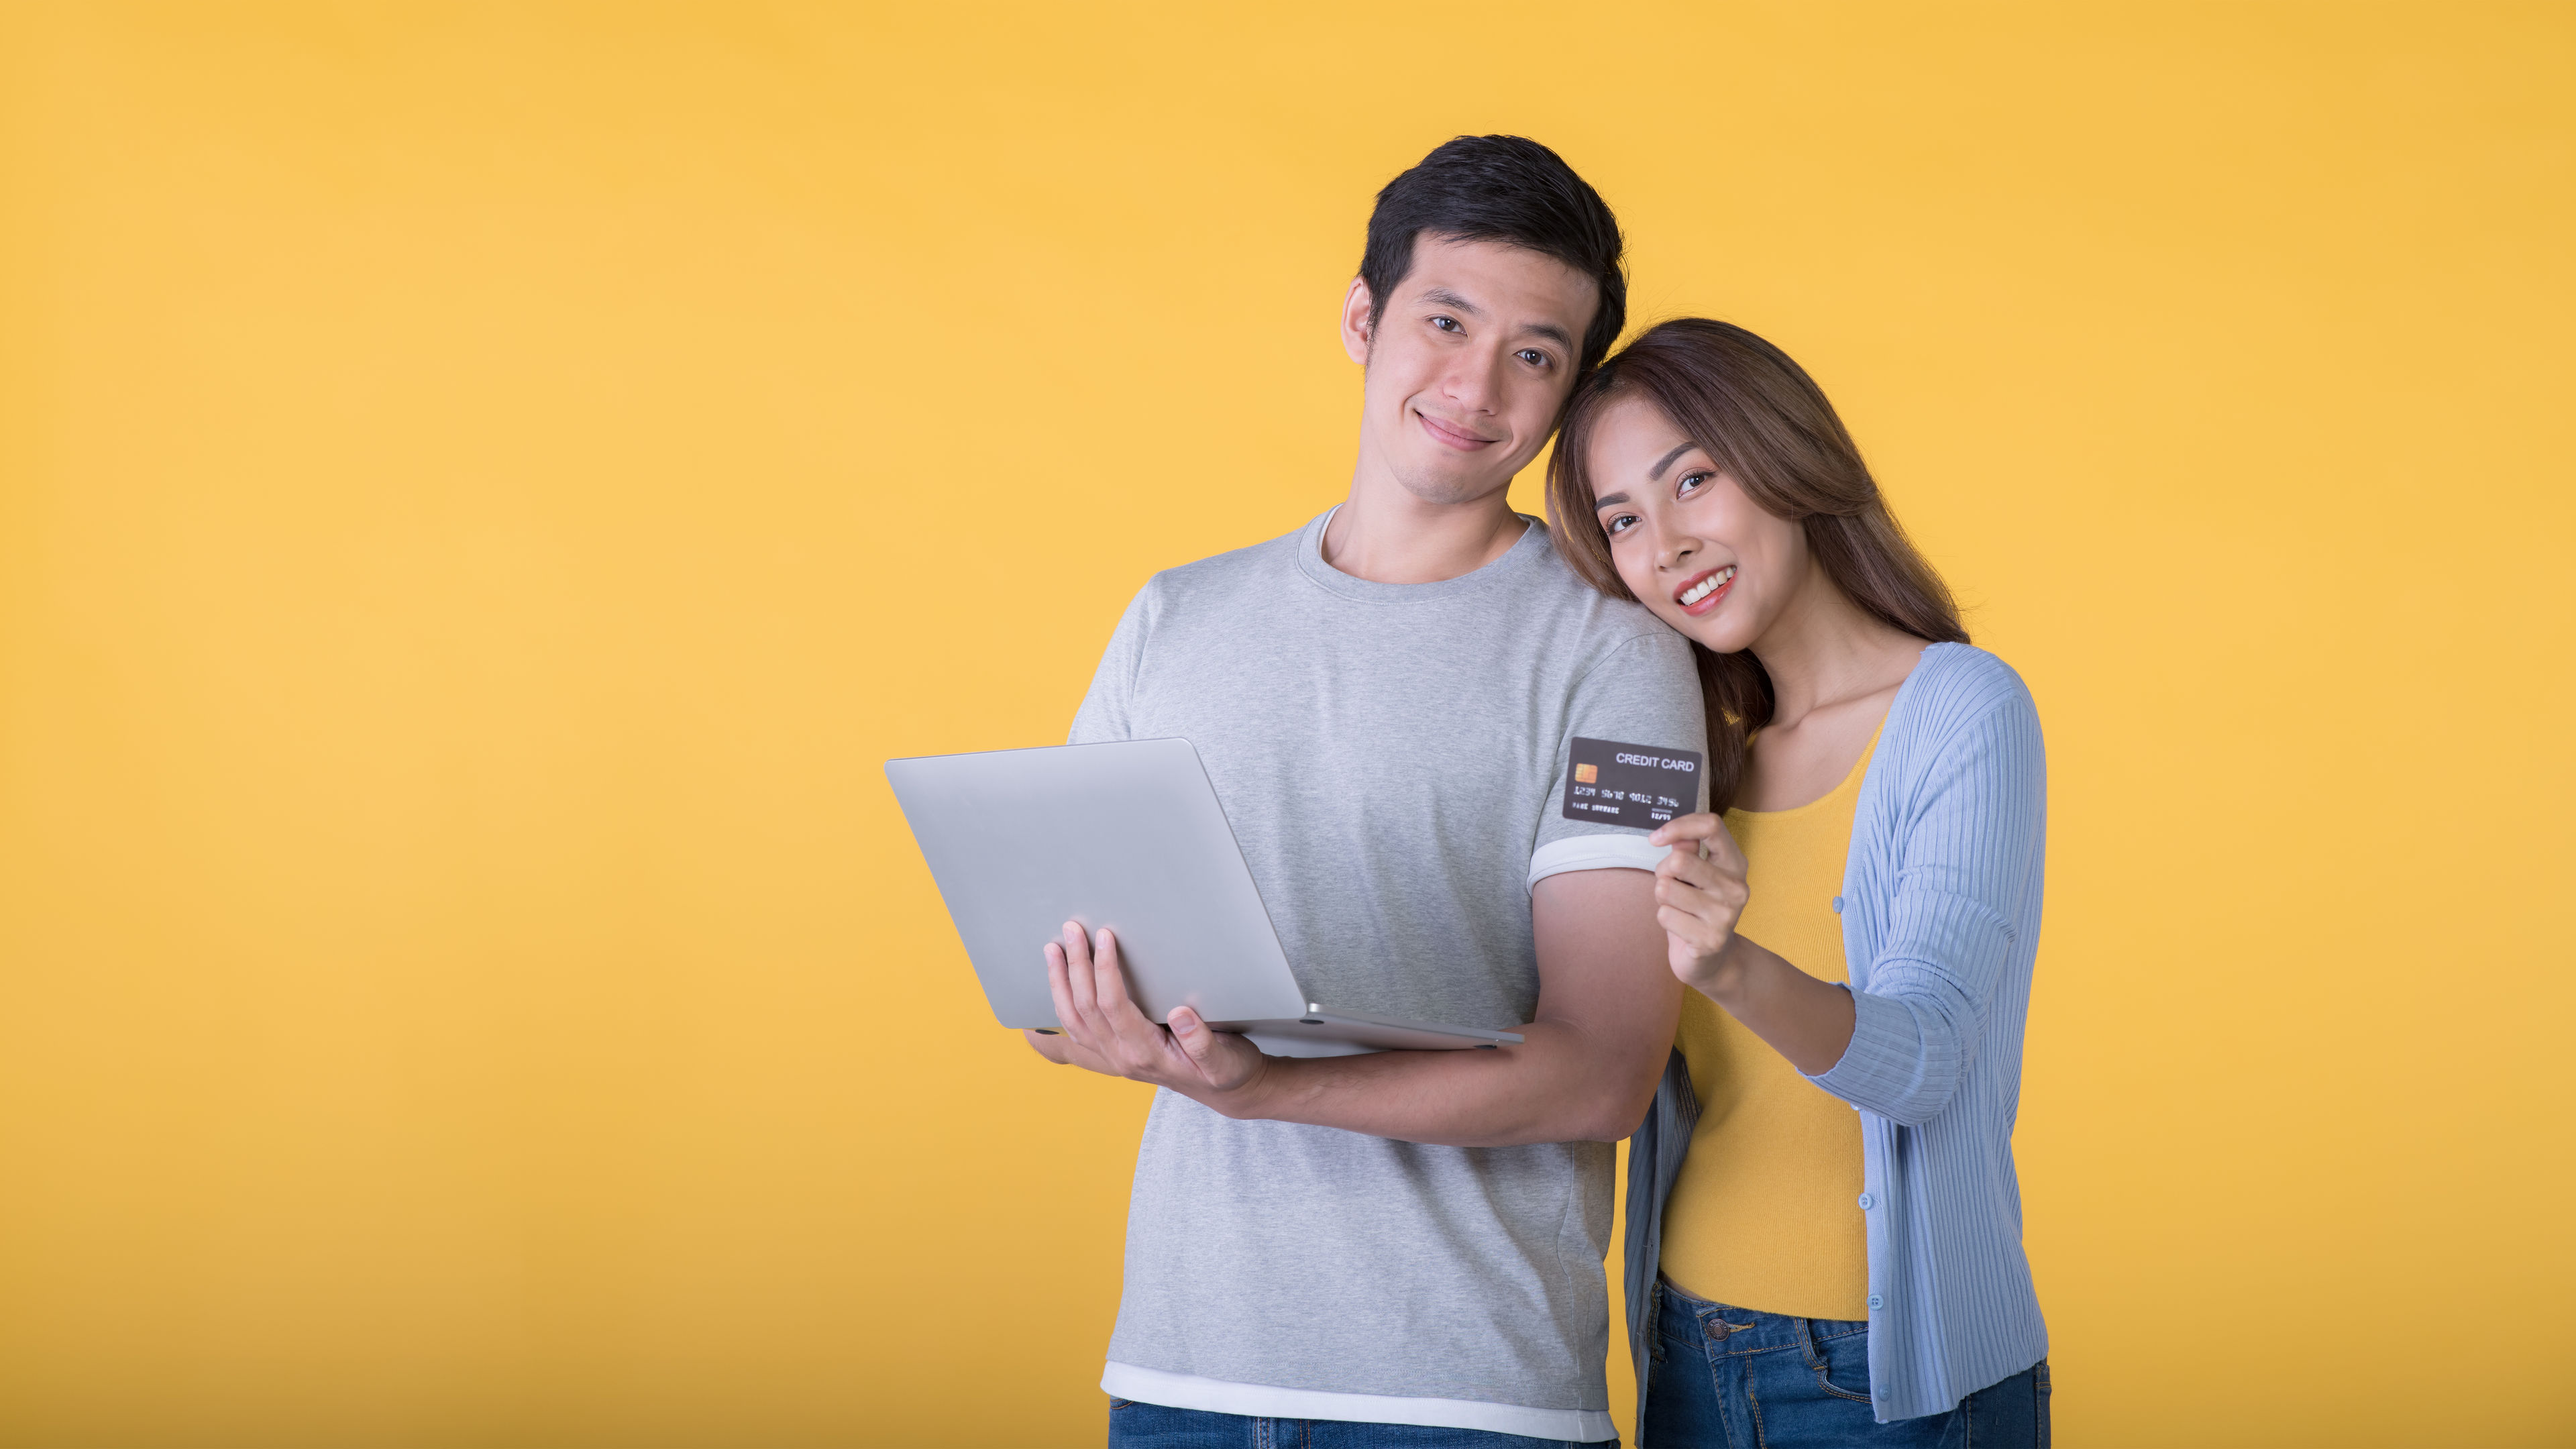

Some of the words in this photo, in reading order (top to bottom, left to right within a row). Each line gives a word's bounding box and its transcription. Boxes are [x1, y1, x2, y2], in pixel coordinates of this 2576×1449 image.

[1616, 753, 1660, 767] CREDIT
[1661, 758, 1695, 772] CARD
[1573, 786, 1596, 796] 1234
[1601, 789, 1625, 800] 5678
[1629, 792, 1652, 804] 9012
[1656, 796, 1679, 808] 3456
